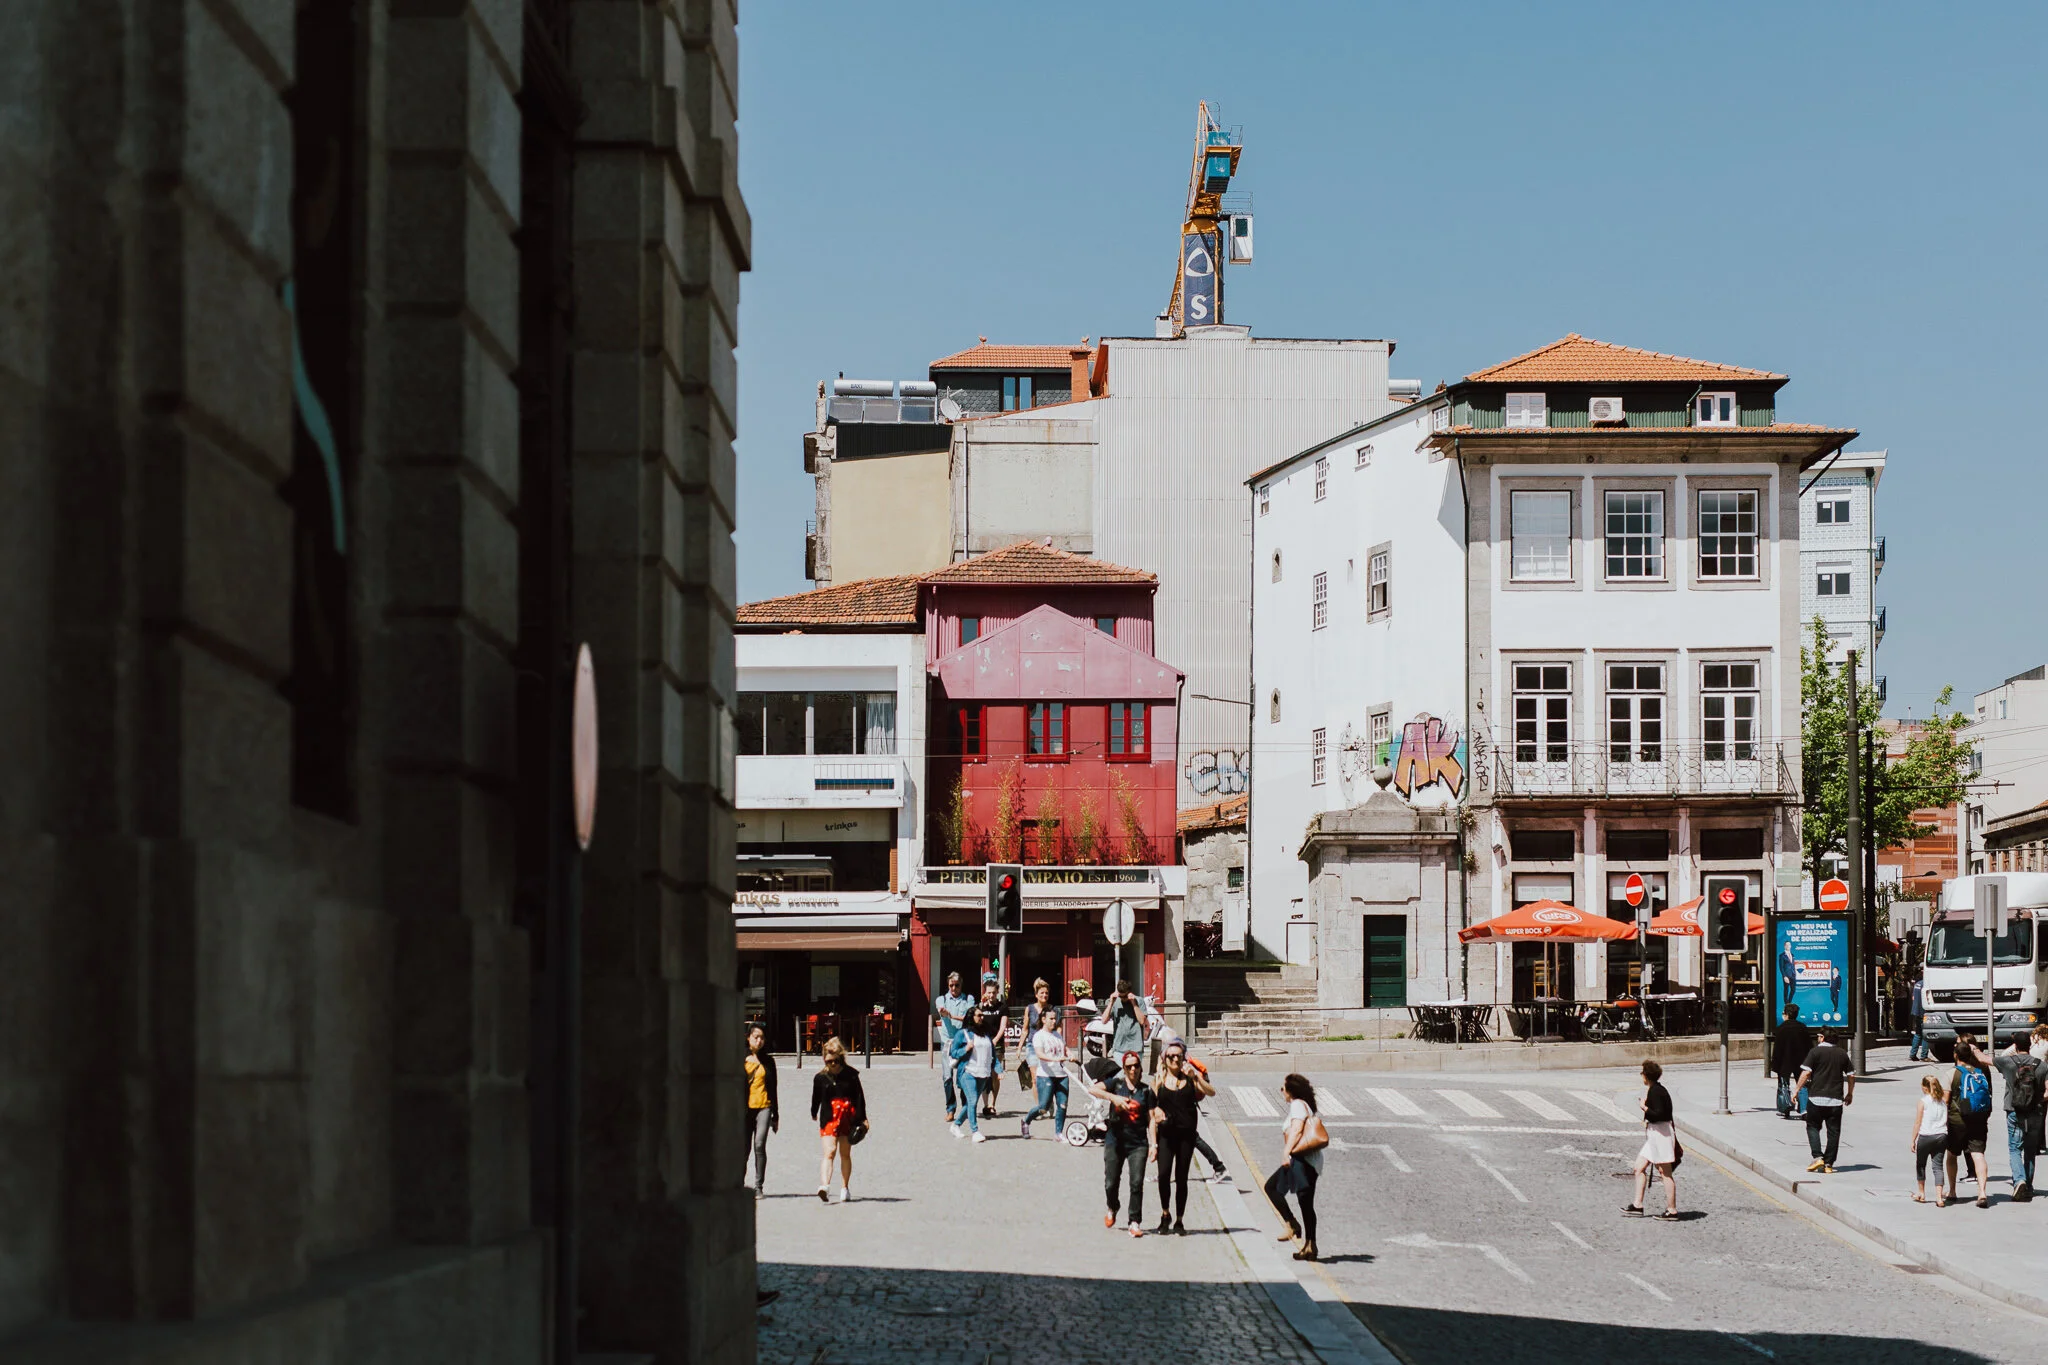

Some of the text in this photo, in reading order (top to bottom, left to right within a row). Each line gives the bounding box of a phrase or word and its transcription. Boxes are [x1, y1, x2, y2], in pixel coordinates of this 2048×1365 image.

[1190, 294, 1208, 320] S
[824, 821, 858, 831] trinkas
[940, 871, 1137, 884] PERR MPAIO EST. 1960
[735, 889, 781, 911] inkas
